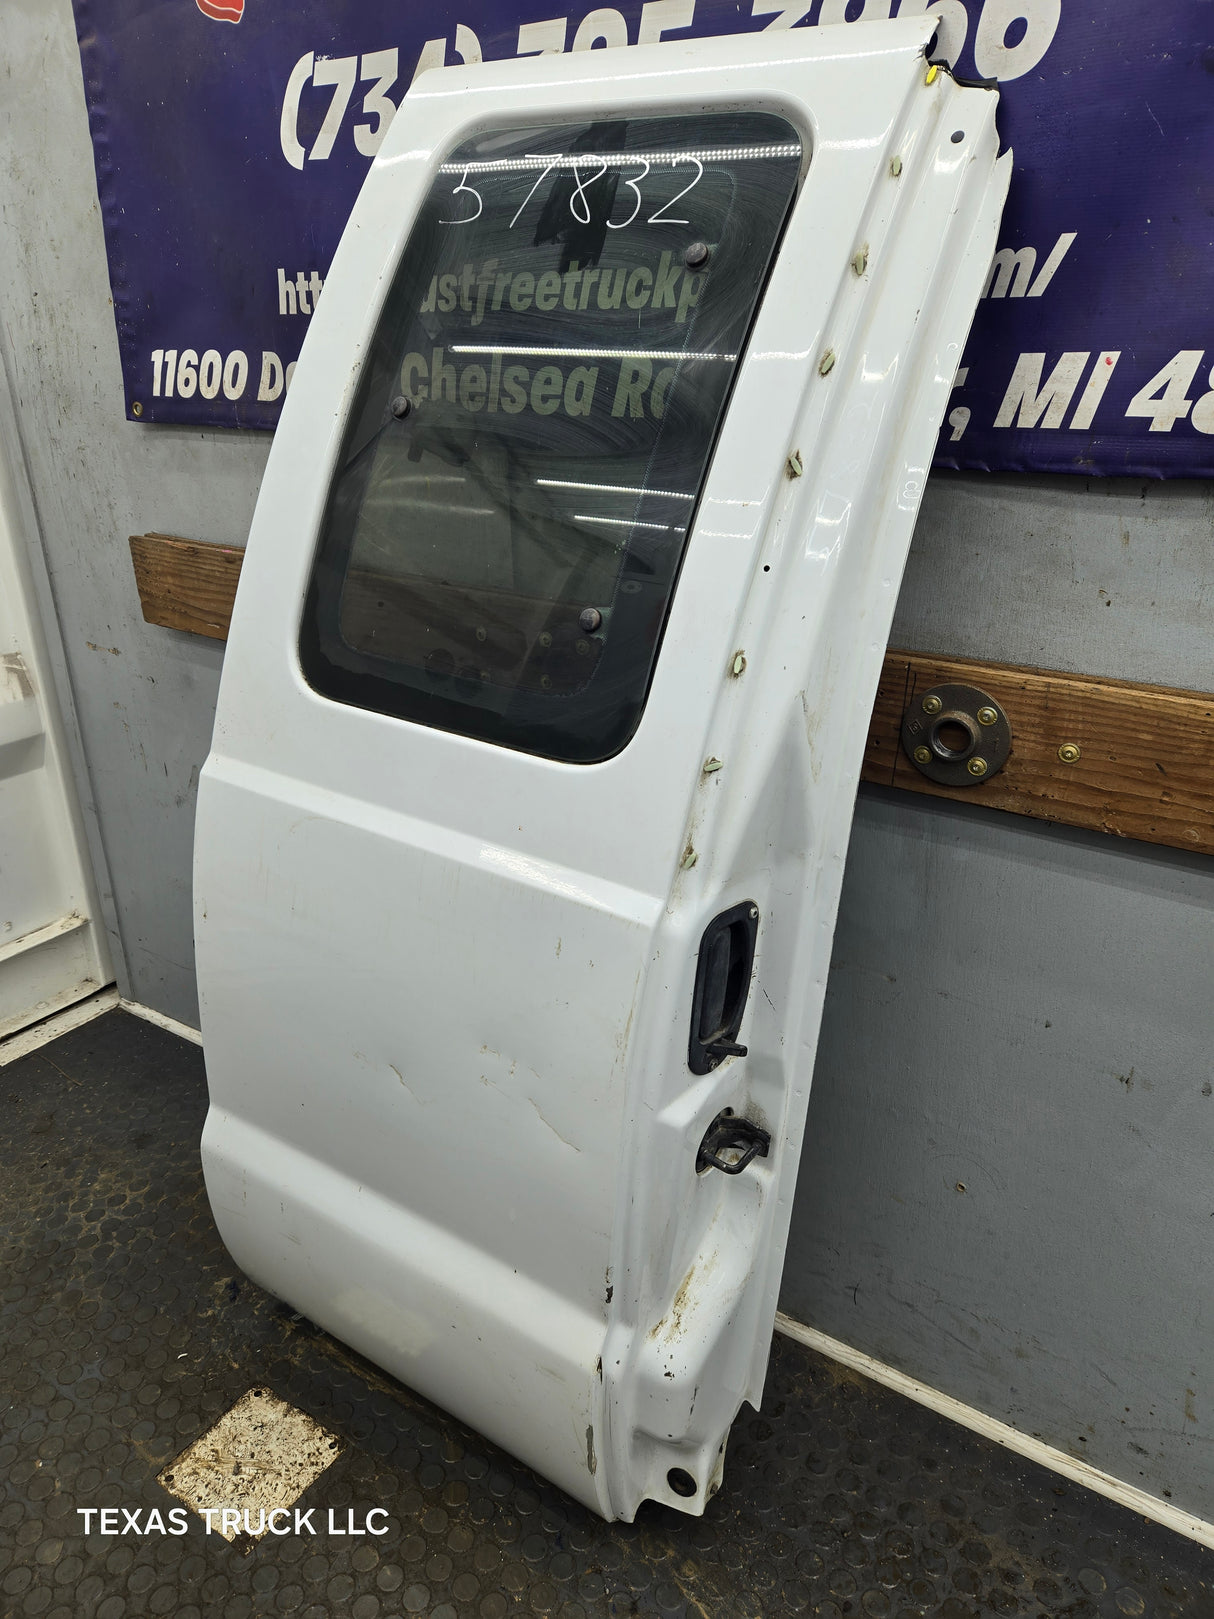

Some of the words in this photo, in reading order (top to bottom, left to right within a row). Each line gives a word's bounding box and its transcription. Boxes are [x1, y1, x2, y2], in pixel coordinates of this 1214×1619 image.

[438, 153, 704, 228] 57832
[151, 349, 249, 401] 11600
[401, 347, 599, 416] Chelsea
[993, 351, 1122, 430] MI
